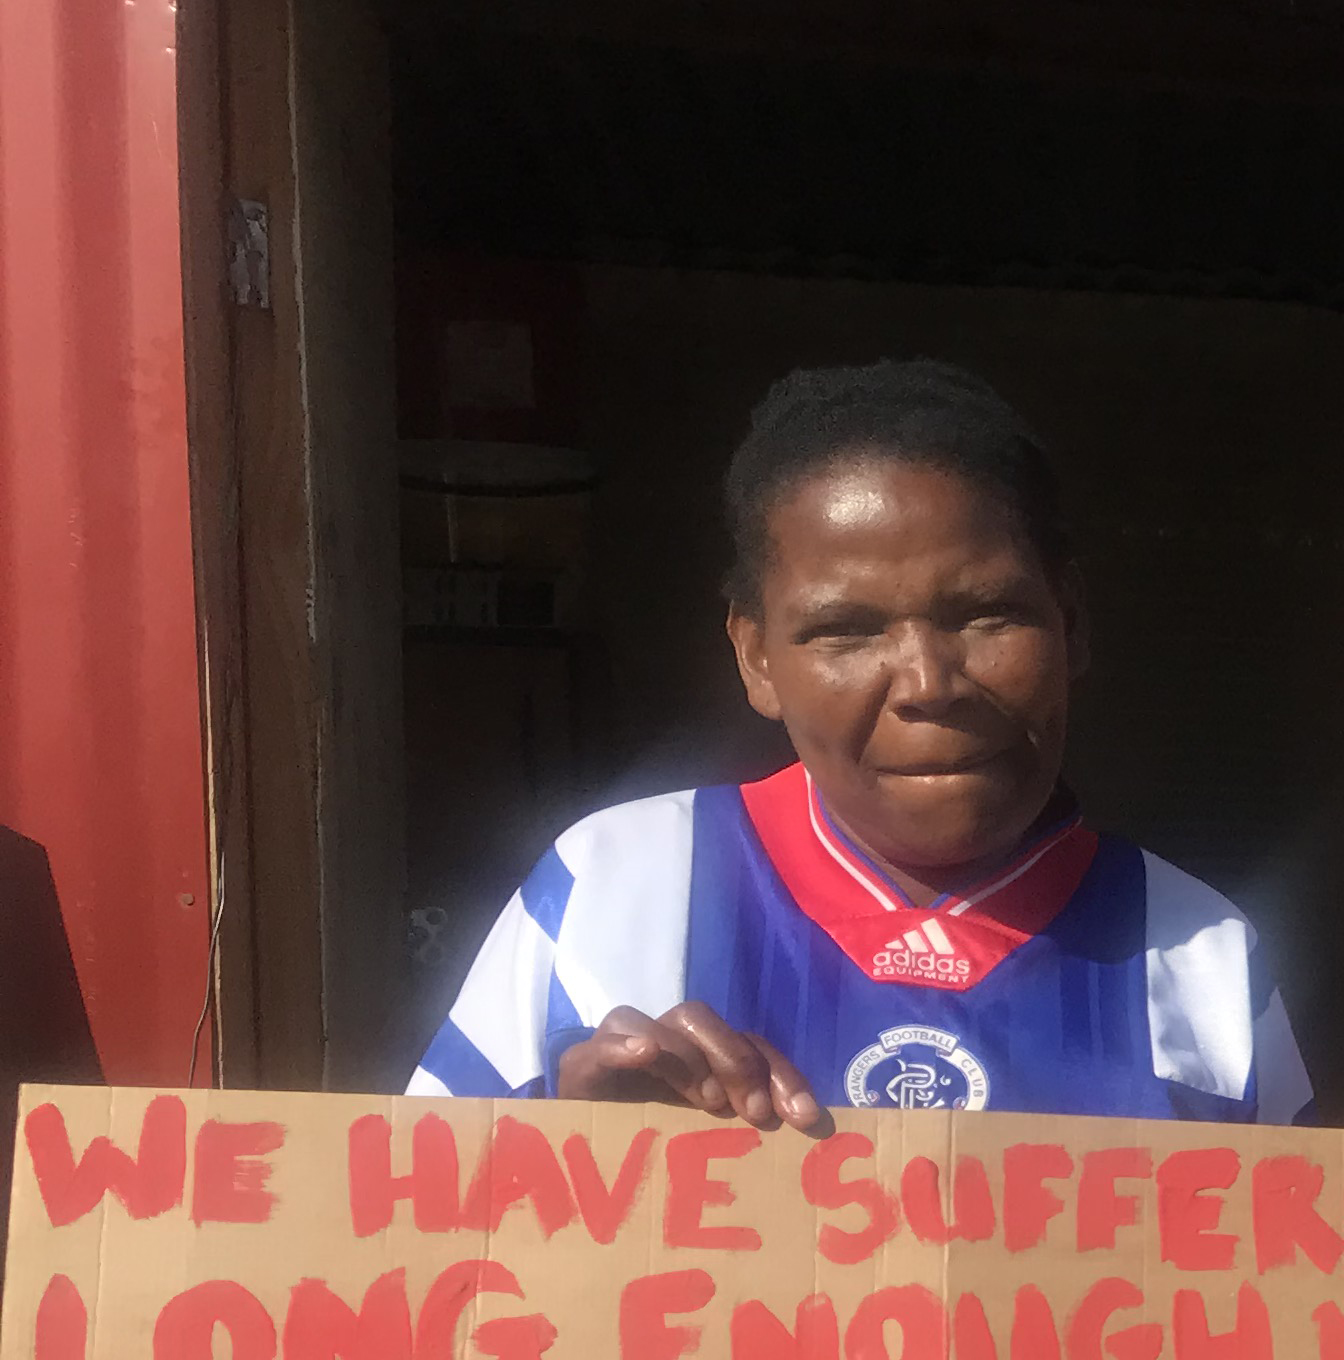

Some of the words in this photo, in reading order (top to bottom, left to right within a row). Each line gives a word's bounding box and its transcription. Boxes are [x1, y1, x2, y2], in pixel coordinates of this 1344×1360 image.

[872, 967, 969, 984] EQUIPMENT
[873, 950, 970, 976] adidas
[852, 1050, 880, 1102] RANGERS
[884, 1030, 953, 1050] FOOTBALL
[961, 1058, 984, 1098] CLUB
[24, 1095, 288, 1228] WE
[348, 1112, 763, 1246] HAVE
